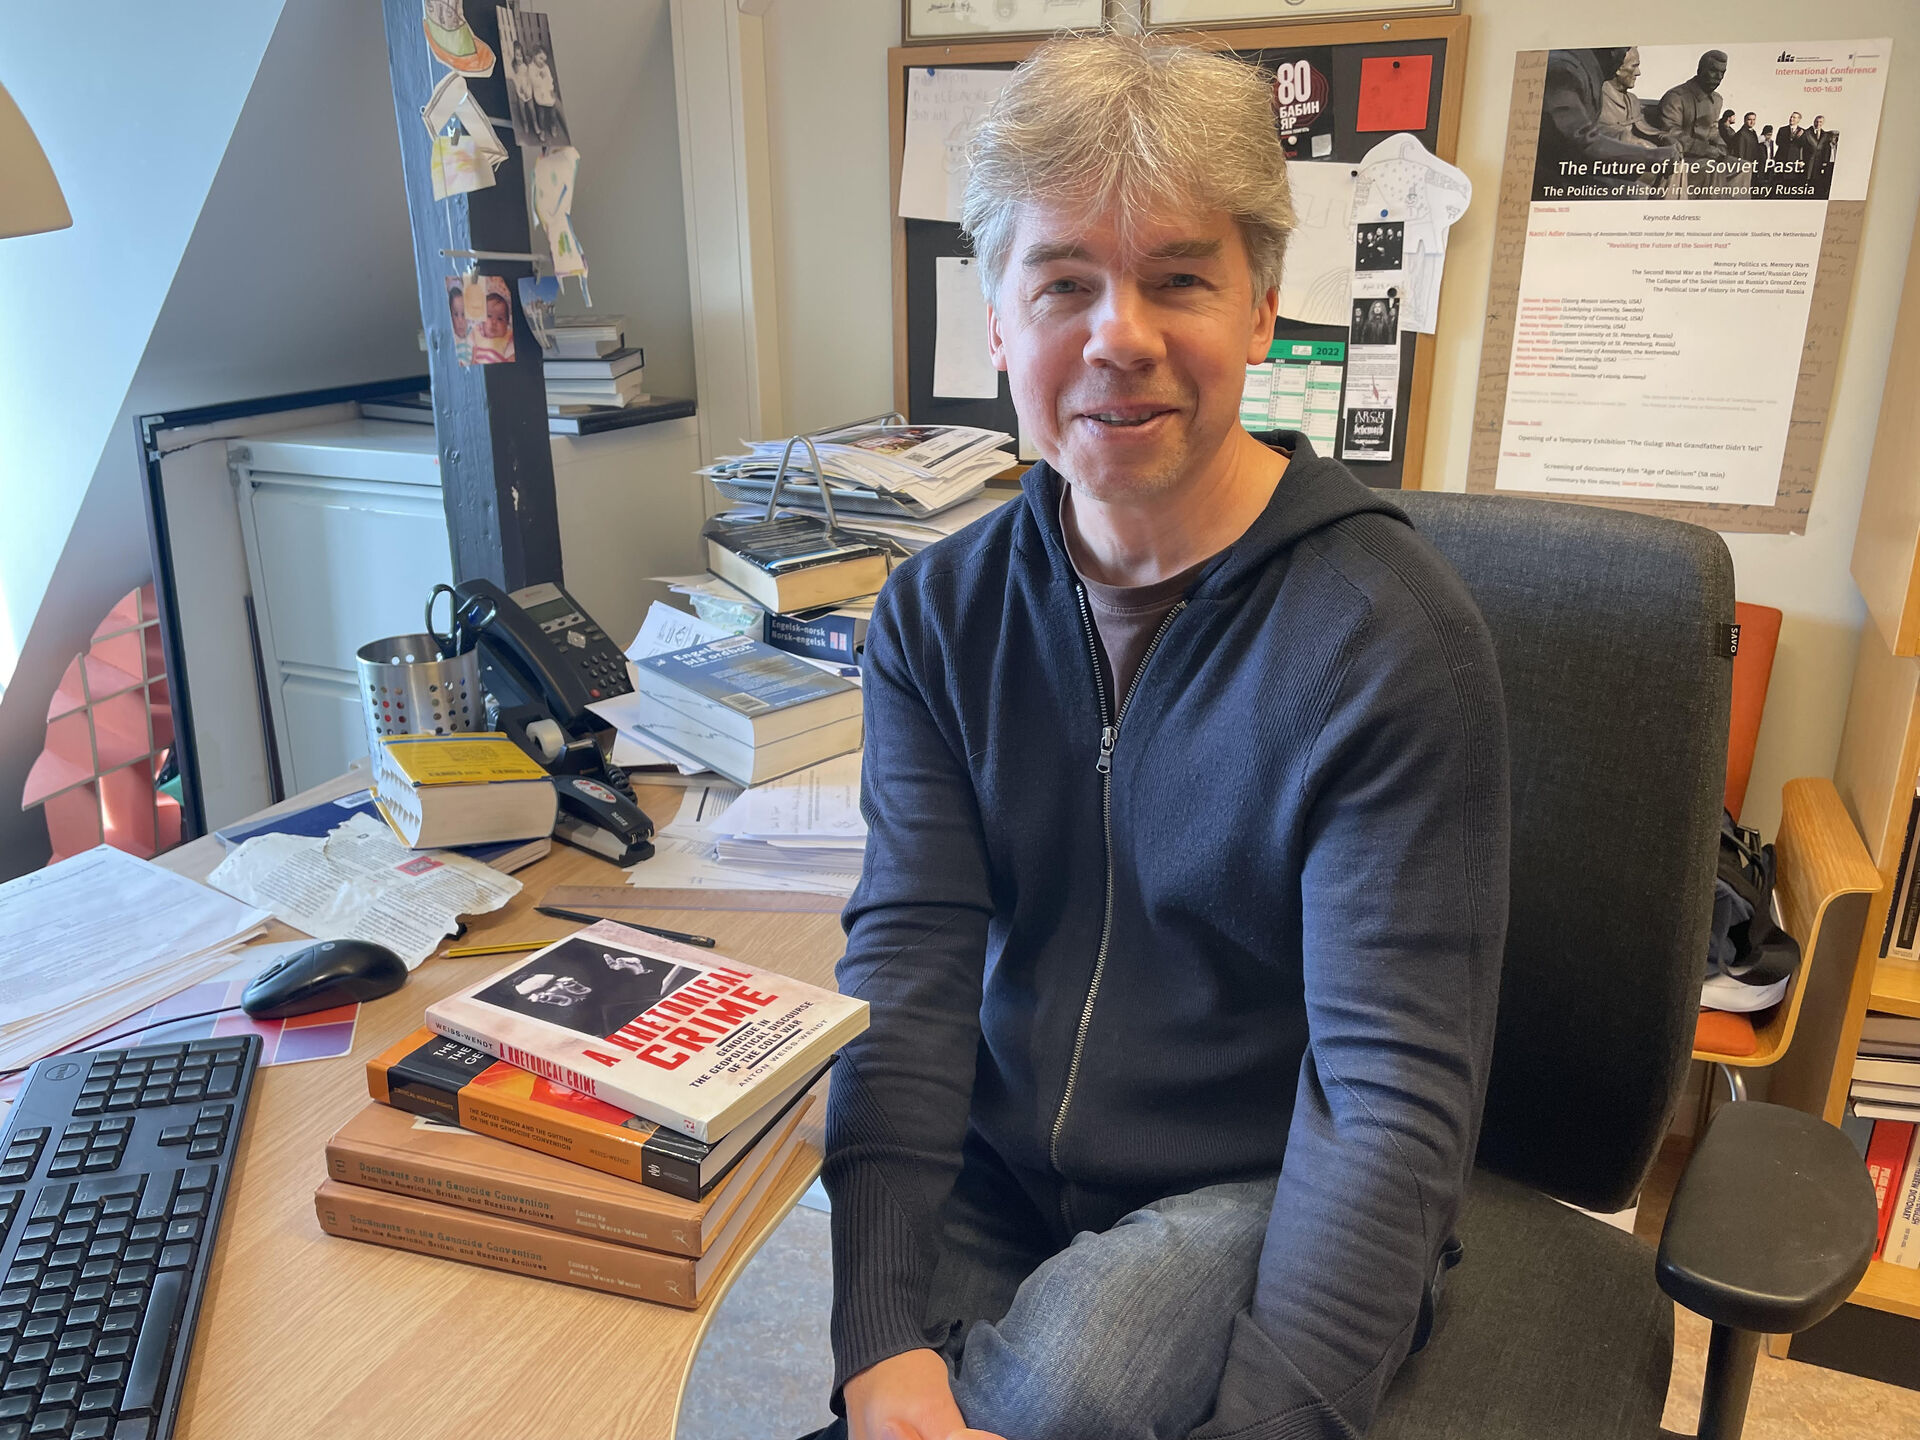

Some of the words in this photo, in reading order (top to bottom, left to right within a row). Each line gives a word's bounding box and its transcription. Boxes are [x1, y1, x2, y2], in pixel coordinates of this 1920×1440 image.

[1277, 59, 1311, 105] 80
[1775, 67, 1828, 76] International
[1830, 66, 1877, 75] Conference
[1279, 100, 1320, 119] БАБИН
[1280, 117, 1297, 130] ЯР
[1558, 160, 1588, 176] The
[1592, 160, 1646, 175] Future
[1650, 159, 1671, 175] of
[1672, 158, 1700, 174] the
[1705, 157, 1759, 174] Soviet
[1764, 158, 1806, 174] Past:
[1543, 185, 1564, 197] The
[1566, 184, 1609, 197] Politics
[1611, 184, 1624, 196] of
[1626, 184, 1669, 198] History
[1671, 184, 1683, 195] in
[1686, 184, 1773, 198] Contemporary
[1775, 183, 1815, 195] Russia
[1642, 214, 1671, 222] Keynote
[1316, 347, 1340, 356] 2022
[1355, 410, 1385, 421] ARCH
[1518, 435, 1544, 443] Opening
[1559, 436, 1592, 445] Temporary
[1593, 438, 1626, 446] Exhibition
[1683, 442, 1724, 450] Grandfather
[1543, 463, 1575, 472] Screening
[1583, 464, 1625, 474] documentary
[1641, 467, 1656, 475] "Age
[1665, 469, 1697, 477] Delirium"
[1709, 471, 1726, 479] min)
[771, 619, 826, 637] Engelsk-norsk
[771, 630, 827, 647] Norsk-engelsk
[1730, 627, 1739, 653] SAVO
[582, 1049, 622, 1068] A
[604, 967, 754, 1052] RHETORICAL
[636, 985, 779, 1071] CRIME
[432, 1042, 458, 1057] THE
[434, 1022, 494, 1050] WEISS-WENDT
[689, 1073, 712, 1088] THE
[709, 1030, 771, 1075] GEOPOLITICAL
[767, 1000, 815, 1034] DISCOURSE
[715, 1025, 760, 1057] GENOCIDE
[757, 1018, 772, 1030] IN
[728, 1062, 743, 1074] OF
[740, 1049, 762, 1065] THE
[759, 1033, 783, 1053] COLD
[781, 1019, 803, 1038] WAR
[447, 1046, 472, 1061] THE
[738, 1063, 770, 1088] ANTON
[770, 1019, 829, 1063] WEISS-WENDT
[499, 1042, 506, 1058] A
[508, 1046, 564, 1082] RHETORICAL
[566, 1071, 598, 1096] CRIME
[469, 1107, 480, 1116] THE
[480, 1110, 500, 1122] SOVIET
[501, 1116, 520, 1128] UNION
[521, 1122, 535, 1132] AND
[535, 1127, 546, 1135] THE
[547, 1130, 573, 1144] GUTTING
[479, 1118, 489, 1126] THE
[490, 1121, 499, 1129] UN
[500, 1124, 531, 1139] GENOCIDE
[532, 1134, 572, 1151] CONVENTION
[359, 1162, 410, 1181] Documents
[413, 1174, 425, 1184] on
[427, 1177, 442, 1188] the
[446, 1180, 491, 1197] Genocide
[494, 1190, 550, 1210] Convention
[360, 1173, 379, 1184] from
[381, 1177, 392, 1186] the
[395, 1180, 434, 1196] American,
[435, 1188, 465, 1201] British,
[467, 1195, 482, 1204] and
[484, 1198, 517, 1213] Russian
[518, 1206, 555, 1220] Archives
[1901, 1189, 1918, 1221] DICTIONARY
[350, 1214, 401, 1233] Documents
[404, 1226, 416, 1235] on
[419, 1229, 434, 1240] the
[437, 1232, 483, 1249] Genocide
[486, 1241, 543, 1262] Convention
[351, 1225, 370, 1235] from
[372, 1229, 384, 1237] the
[386, 1231, 426, 1247] American,
[459, 1246, 474, 1255] and
[476, 1250, 510, 1264] Russian
[511, 1257, 548, 1271] Archives
